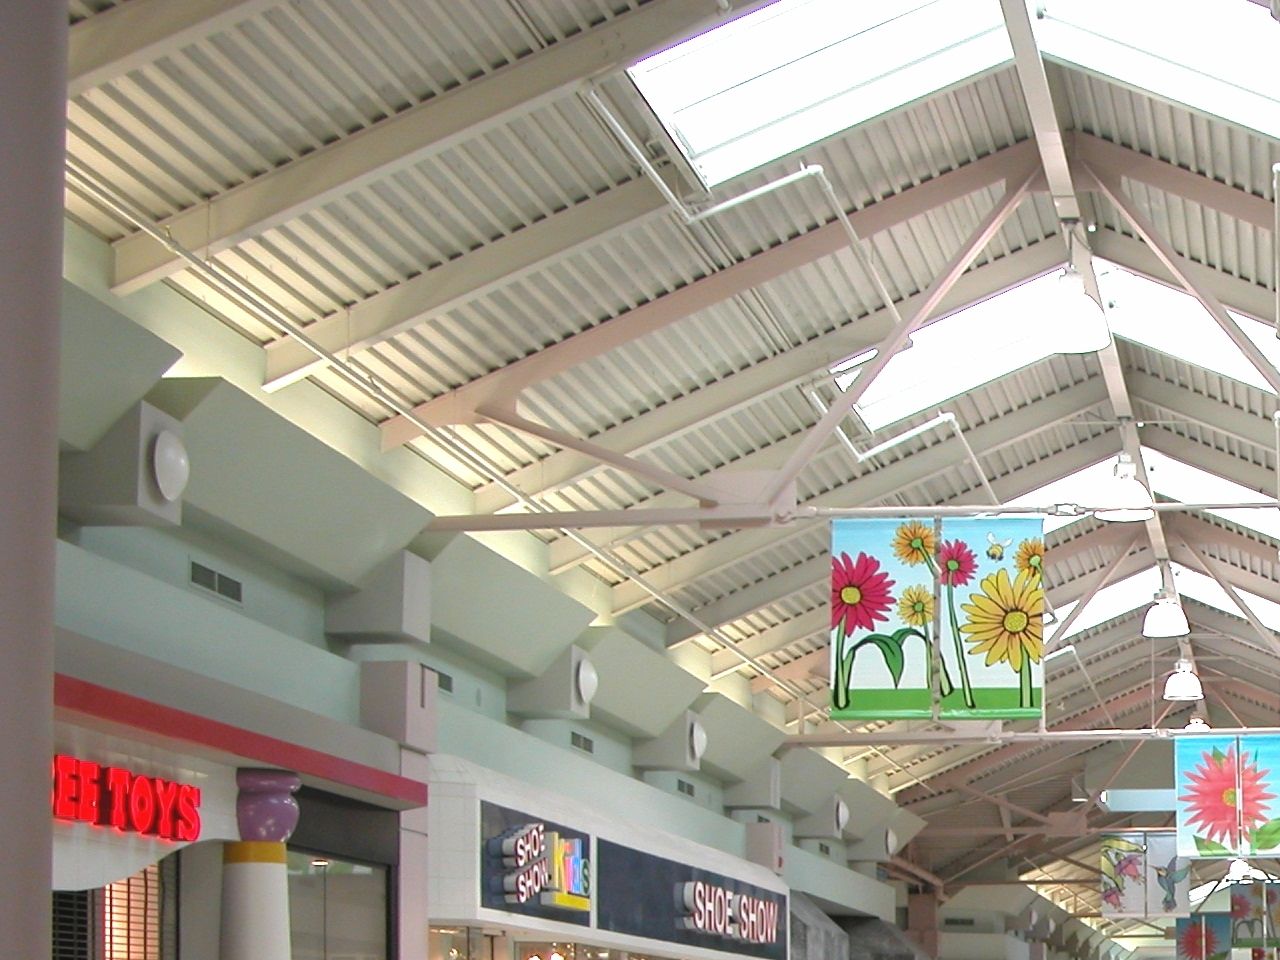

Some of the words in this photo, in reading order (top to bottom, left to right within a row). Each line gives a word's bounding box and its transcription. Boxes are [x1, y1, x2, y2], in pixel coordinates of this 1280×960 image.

[53, 755, 100, 824] EE
[107, 767, 201, 841] TOYS
[514, 823, 545, 868] SHOE
[553, 831, 590, 896] Kids
[515, 857, 549, 904] SHOW
[694, 881, 733, 935] SHOE
[740, 894, 778, 943] SHOW
